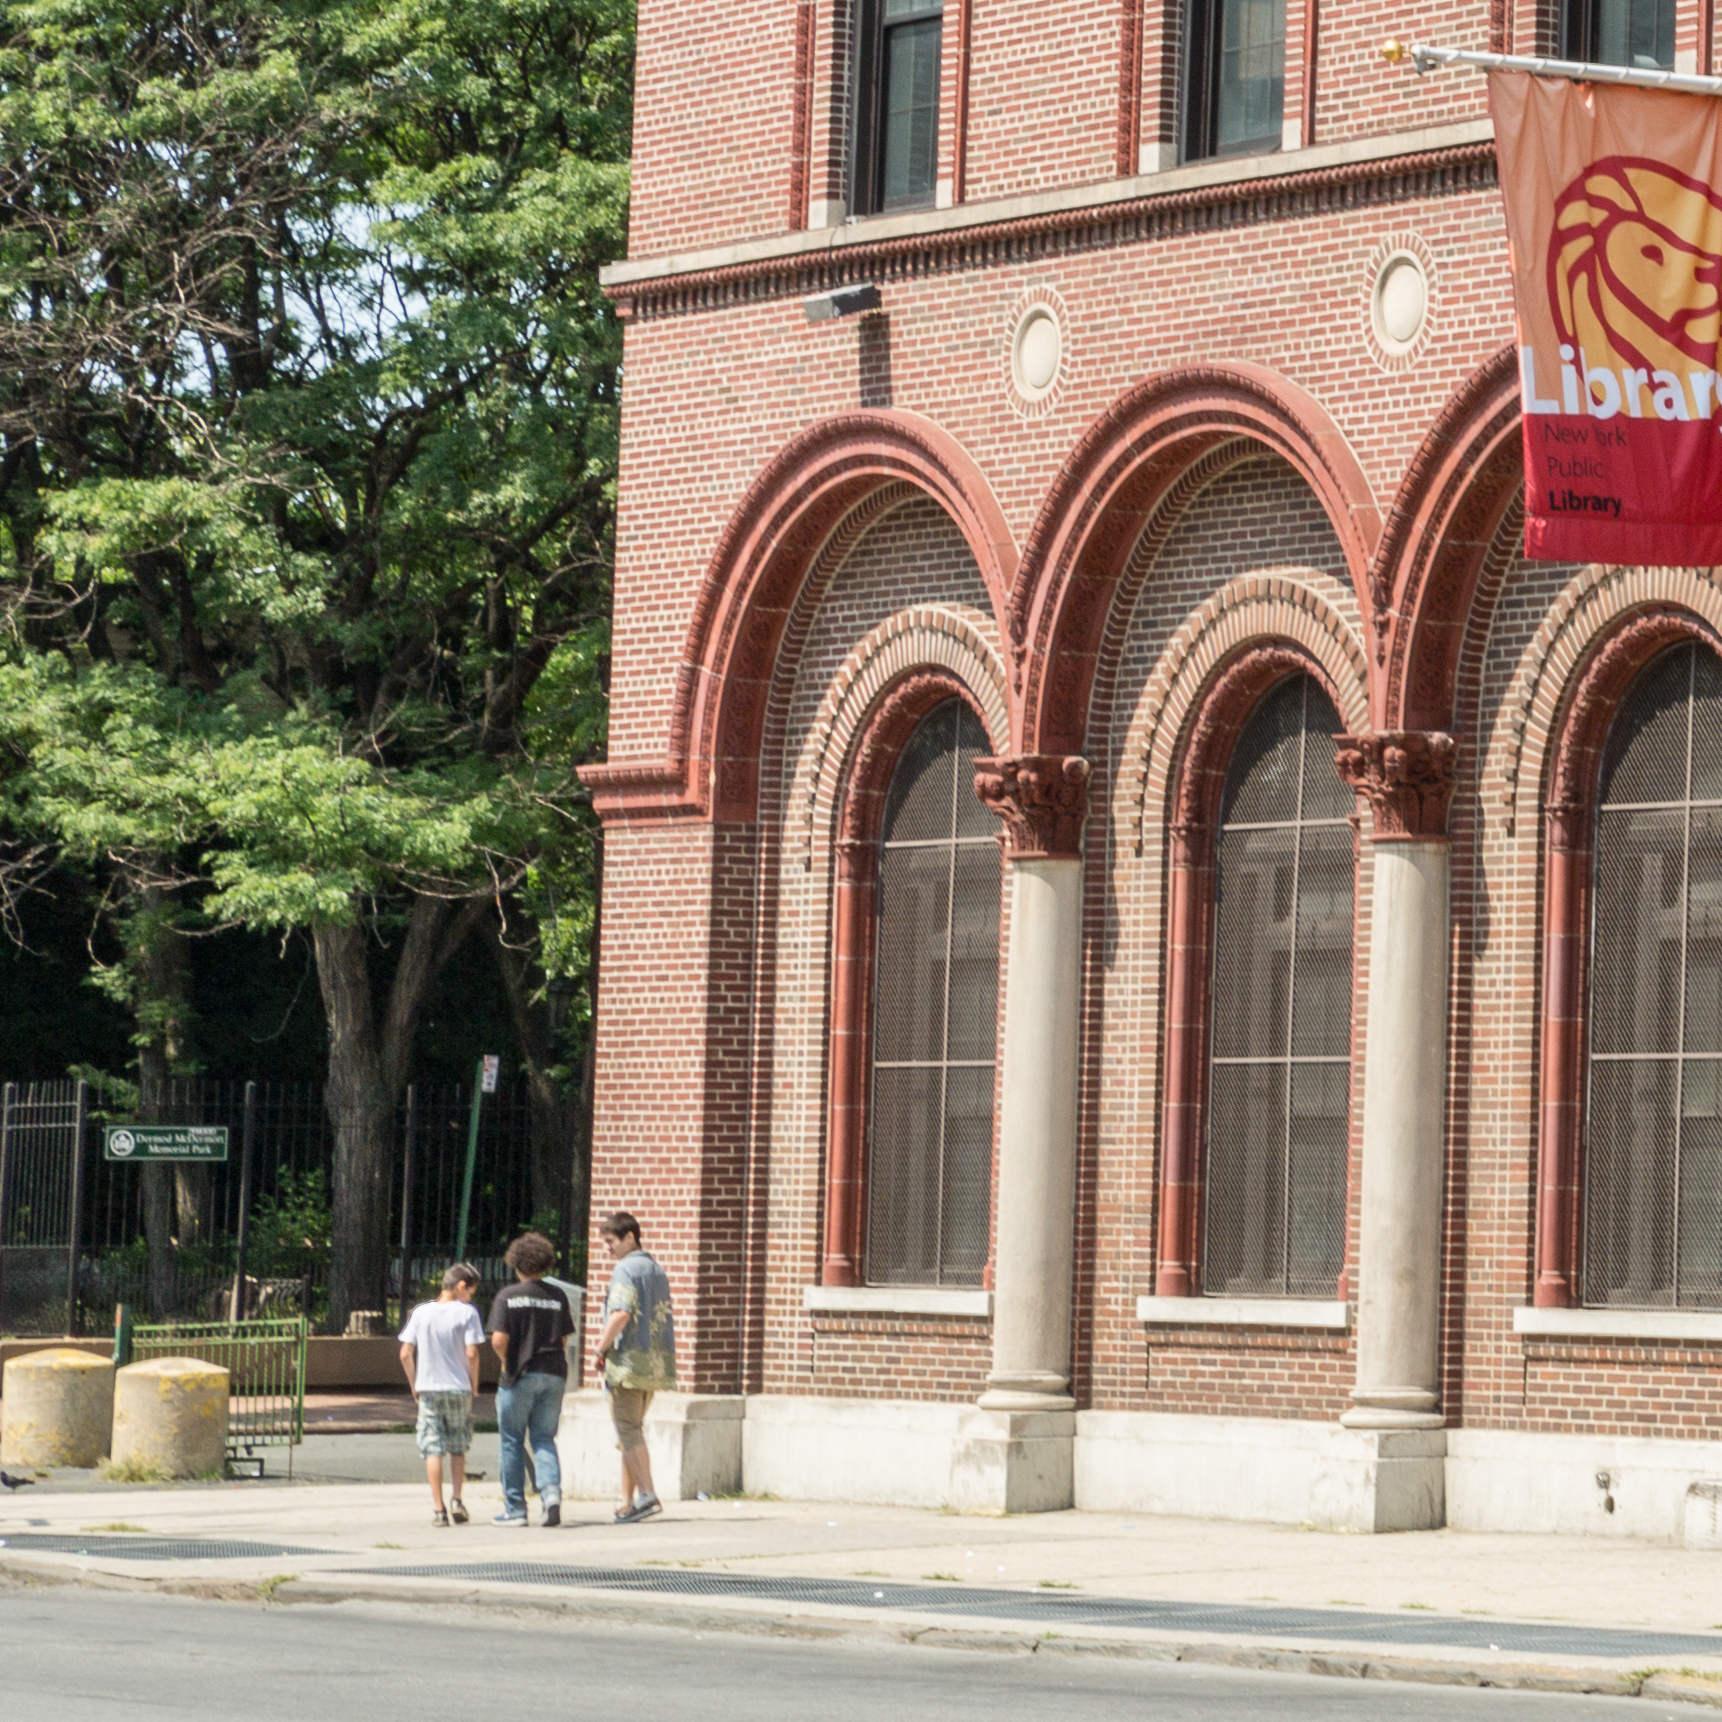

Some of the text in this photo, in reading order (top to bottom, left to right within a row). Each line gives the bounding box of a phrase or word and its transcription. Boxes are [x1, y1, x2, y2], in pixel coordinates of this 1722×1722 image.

[1544, 422, 1588, 444] New
[1546, 455, 1605, 479] Public
[1549, 489, 1623, 518] Library
[148, 1144, 213, 1154] Memorial Park
